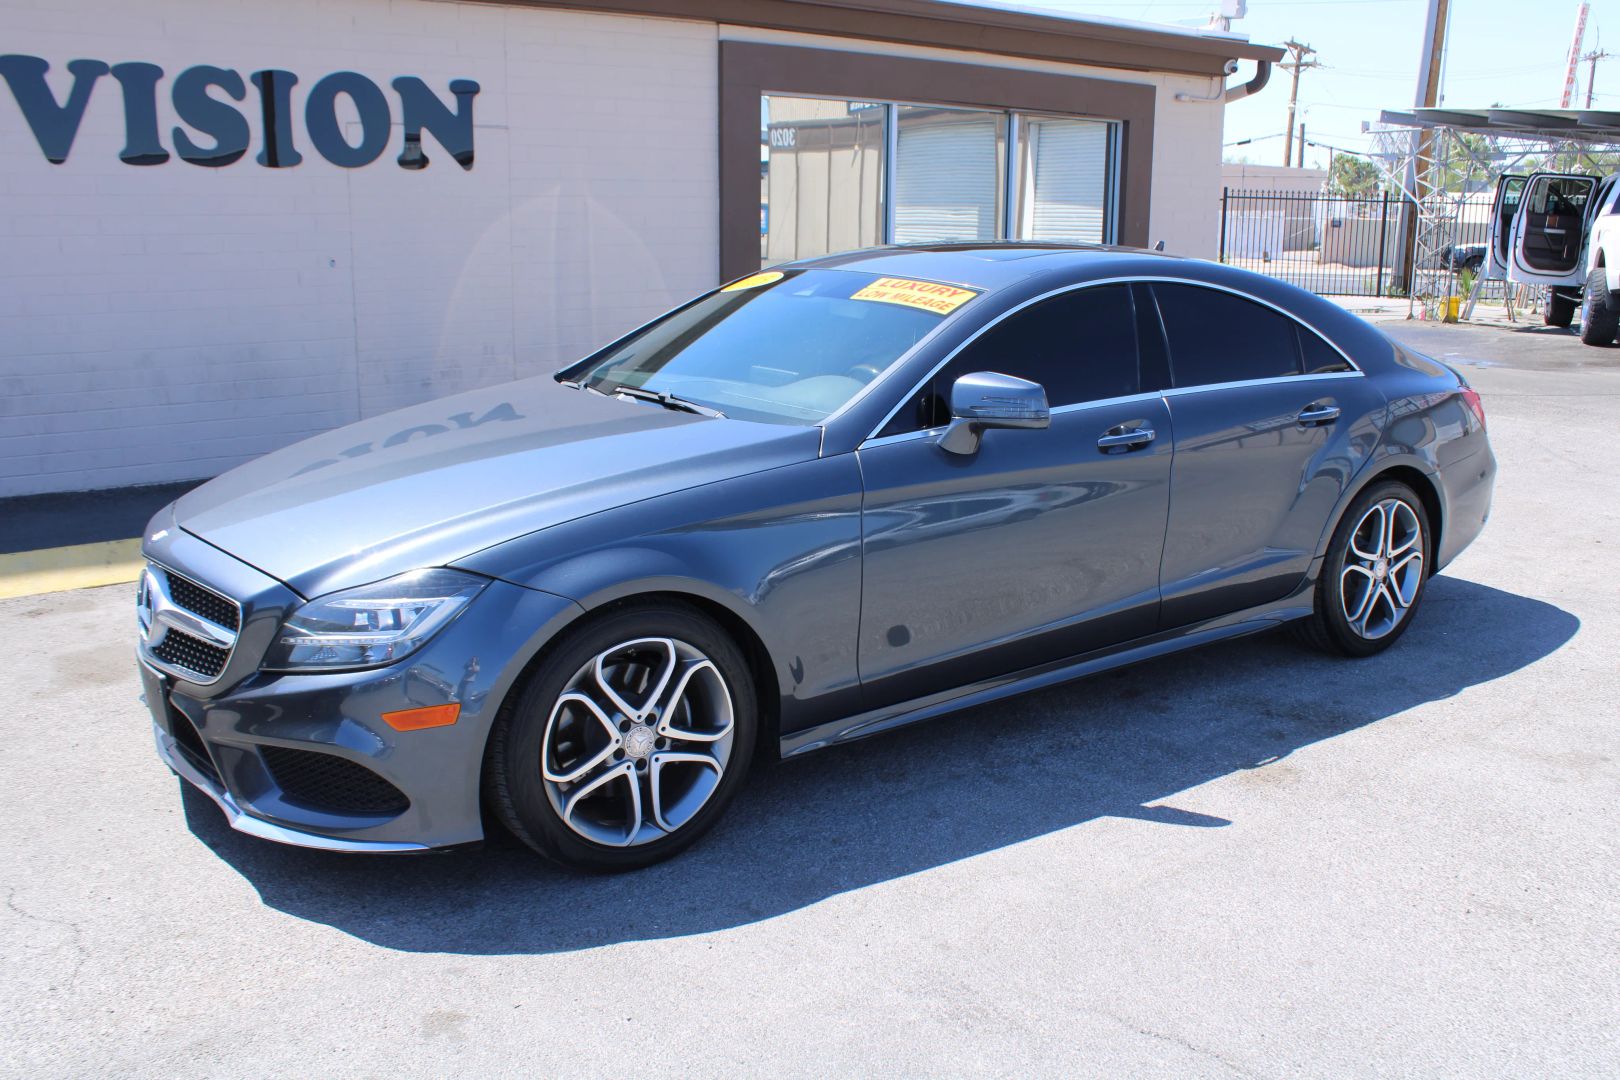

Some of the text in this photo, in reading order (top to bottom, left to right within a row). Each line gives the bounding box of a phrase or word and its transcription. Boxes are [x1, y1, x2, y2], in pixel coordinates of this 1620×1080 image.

[0, 54, 481, 171] VISION
[879, 279, 967, 298] LUXURY
[890, 292, 957, 311] MILEAGE
